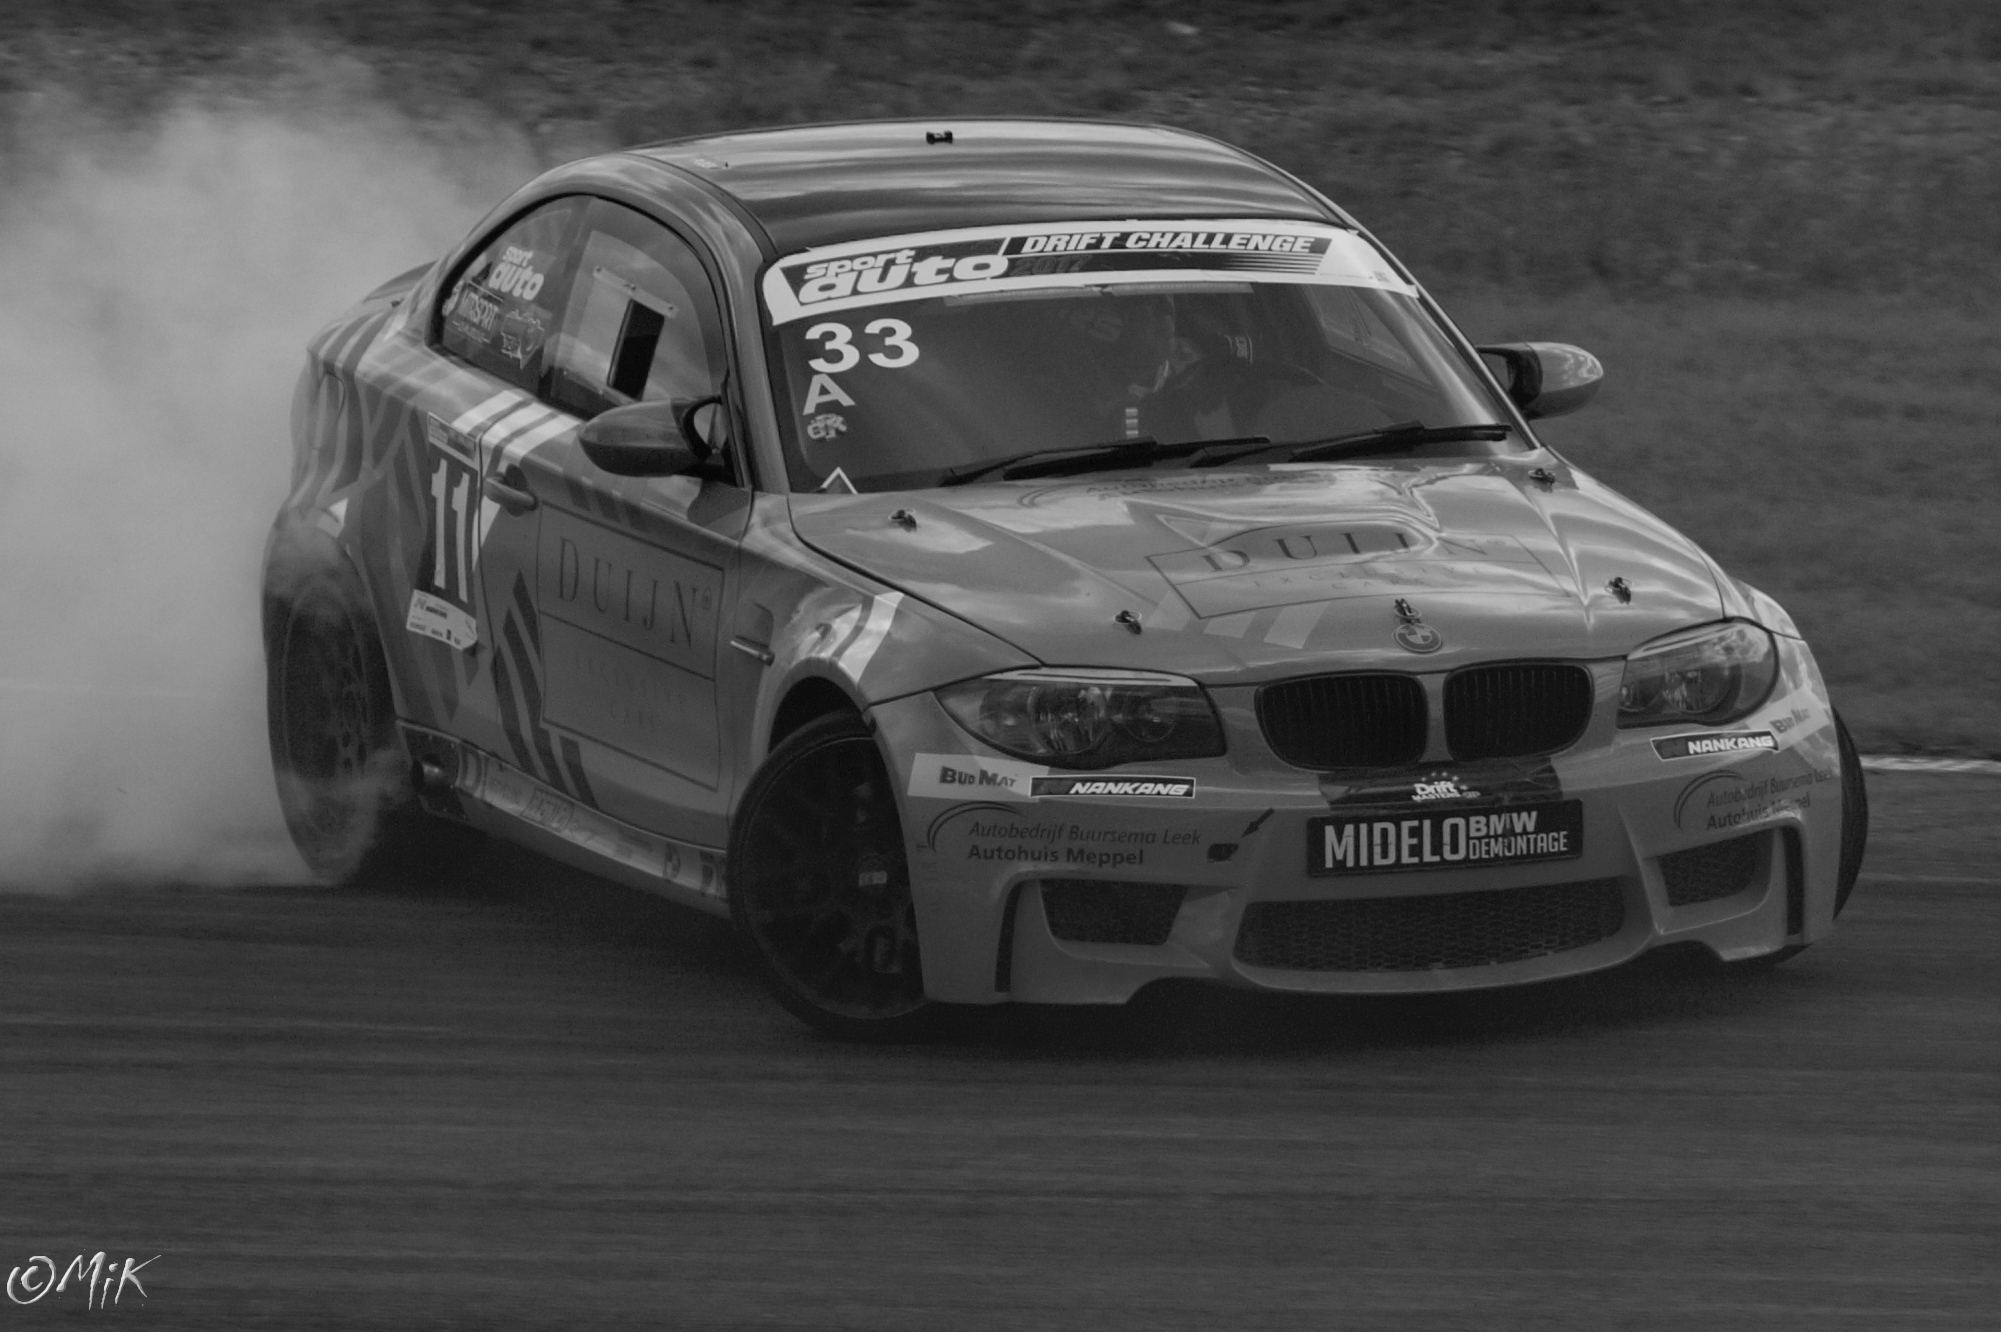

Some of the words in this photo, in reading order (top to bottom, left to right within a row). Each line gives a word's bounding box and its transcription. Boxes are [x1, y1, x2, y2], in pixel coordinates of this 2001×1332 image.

[502, 246, 532, 267] sport
[1021, 232, 1121, 254] DRIFT
[1125, 232, 1315, 253] CHALLENGE
[804, 248, 916, 279] sport
[1010, 254, 1093, 276] 2017
[488, 261, 544, 300] auto
[798, 254, 1010, 304] auto
[805, 318, 920, 373] 33
[802, 373, 857, 416] A
[430, 457, 471, 604] 11
[1687, 735, 1774, 754] NANKANG
[1068, 781, 1190, 796] NANKANG
[1413, 779, 1459, 796] Drift
[968, 820, 1065, 844] Autobedrijf
[1069, 825, 1156, 845] Buursema
[1162, 828, 1201, 846] Leek
[1469, 810, 1538, 837] BMW
[967, 843, 1059, 863] Autohuis
[1066, 846, 1144, 868] Meppel
[1324, 816, 1467, 869] MIDELO
[1469, 830, 1568, 860] DEMONTAGE
